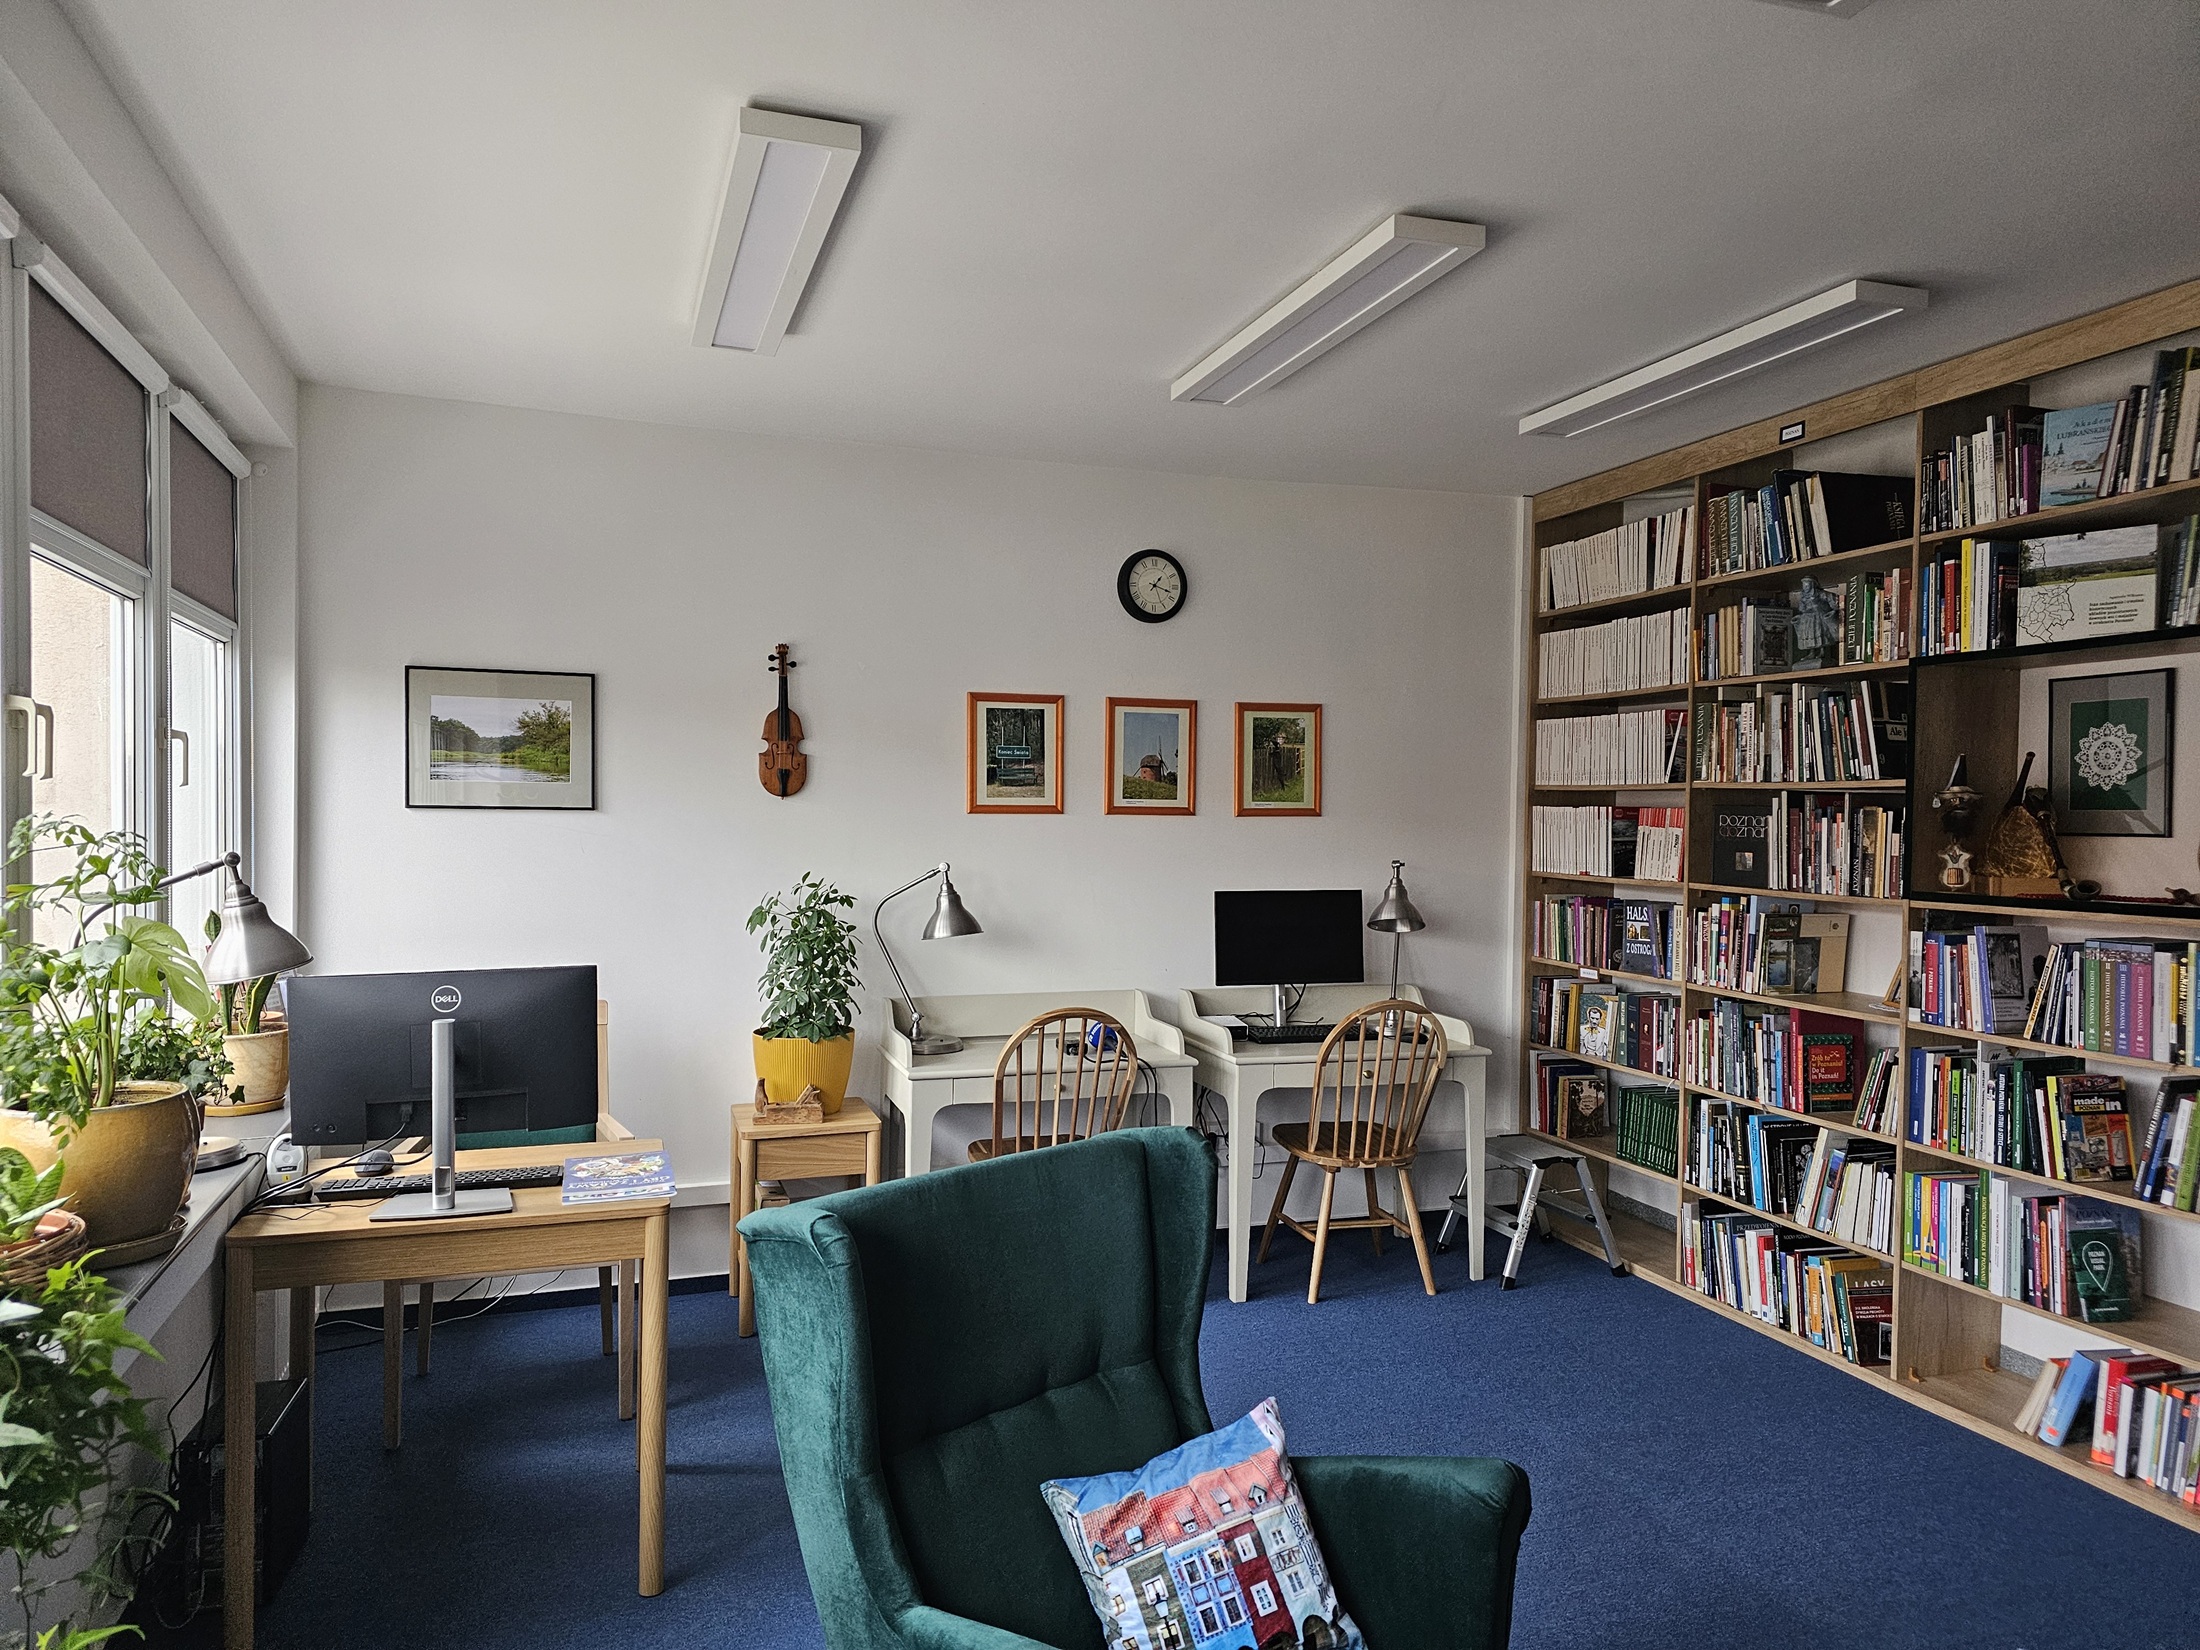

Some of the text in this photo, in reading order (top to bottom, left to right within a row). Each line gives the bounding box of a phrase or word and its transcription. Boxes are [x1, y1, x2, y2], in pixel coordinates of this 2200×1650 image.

[1014, 748, 1029, 756] Świata
[1626, 905, 1648, 921] HALS
[1631, 943, 1652, 956] OSTROG
[2074, 1096, 2122, 1111] made in
